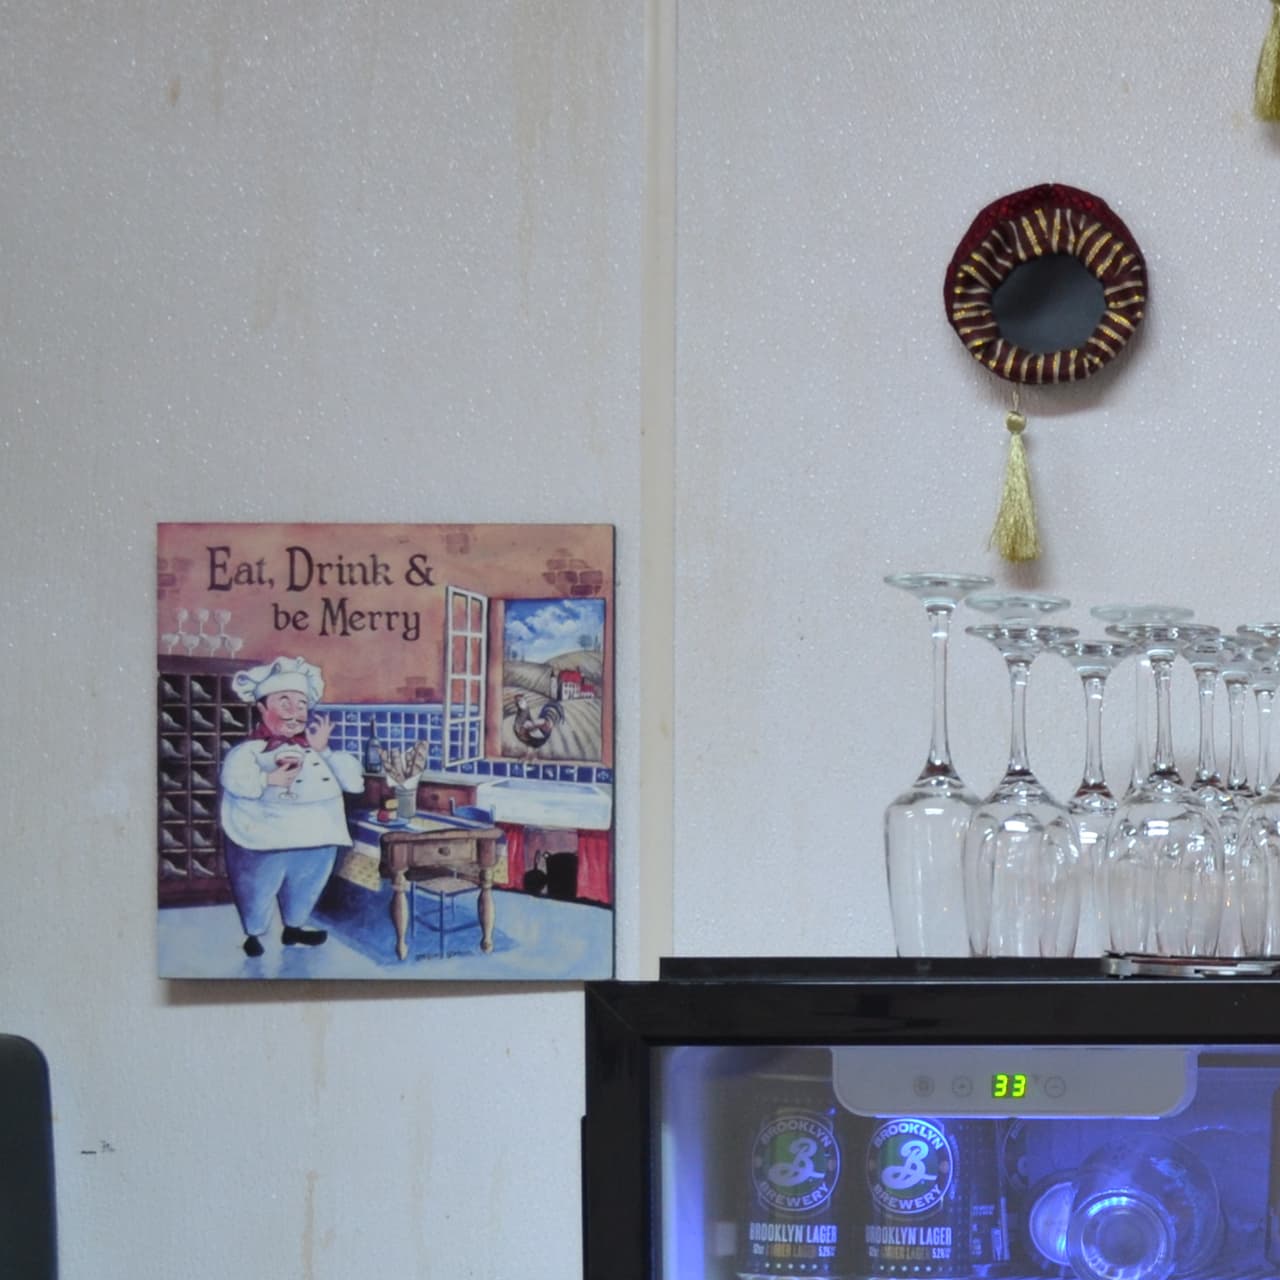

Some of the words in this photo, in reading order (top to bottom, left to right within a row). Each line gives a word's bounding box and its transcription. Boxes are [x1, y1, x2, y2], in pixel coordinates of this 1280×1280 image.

[207, 546, 274, 592] Eat,
[287, 546, 394, 592] Drink
[406, 554, 434, 587] &
[273, 603, 308, 631] be
[319, 598, 421, 640] Merry
[992, 1074, 1027, 1098] 33
[873, 1120, 944, 1149] BROOKLYN
[873, 1184, 942, 1210] BREWERY
[750, 1223, 804, 1242] BROOKLYN
[807, 1224, 837, 1242] LAGER
[866, 1225, 919, 1244] BROOKLYN
[920, 1226, 952, 1245] LAGER
